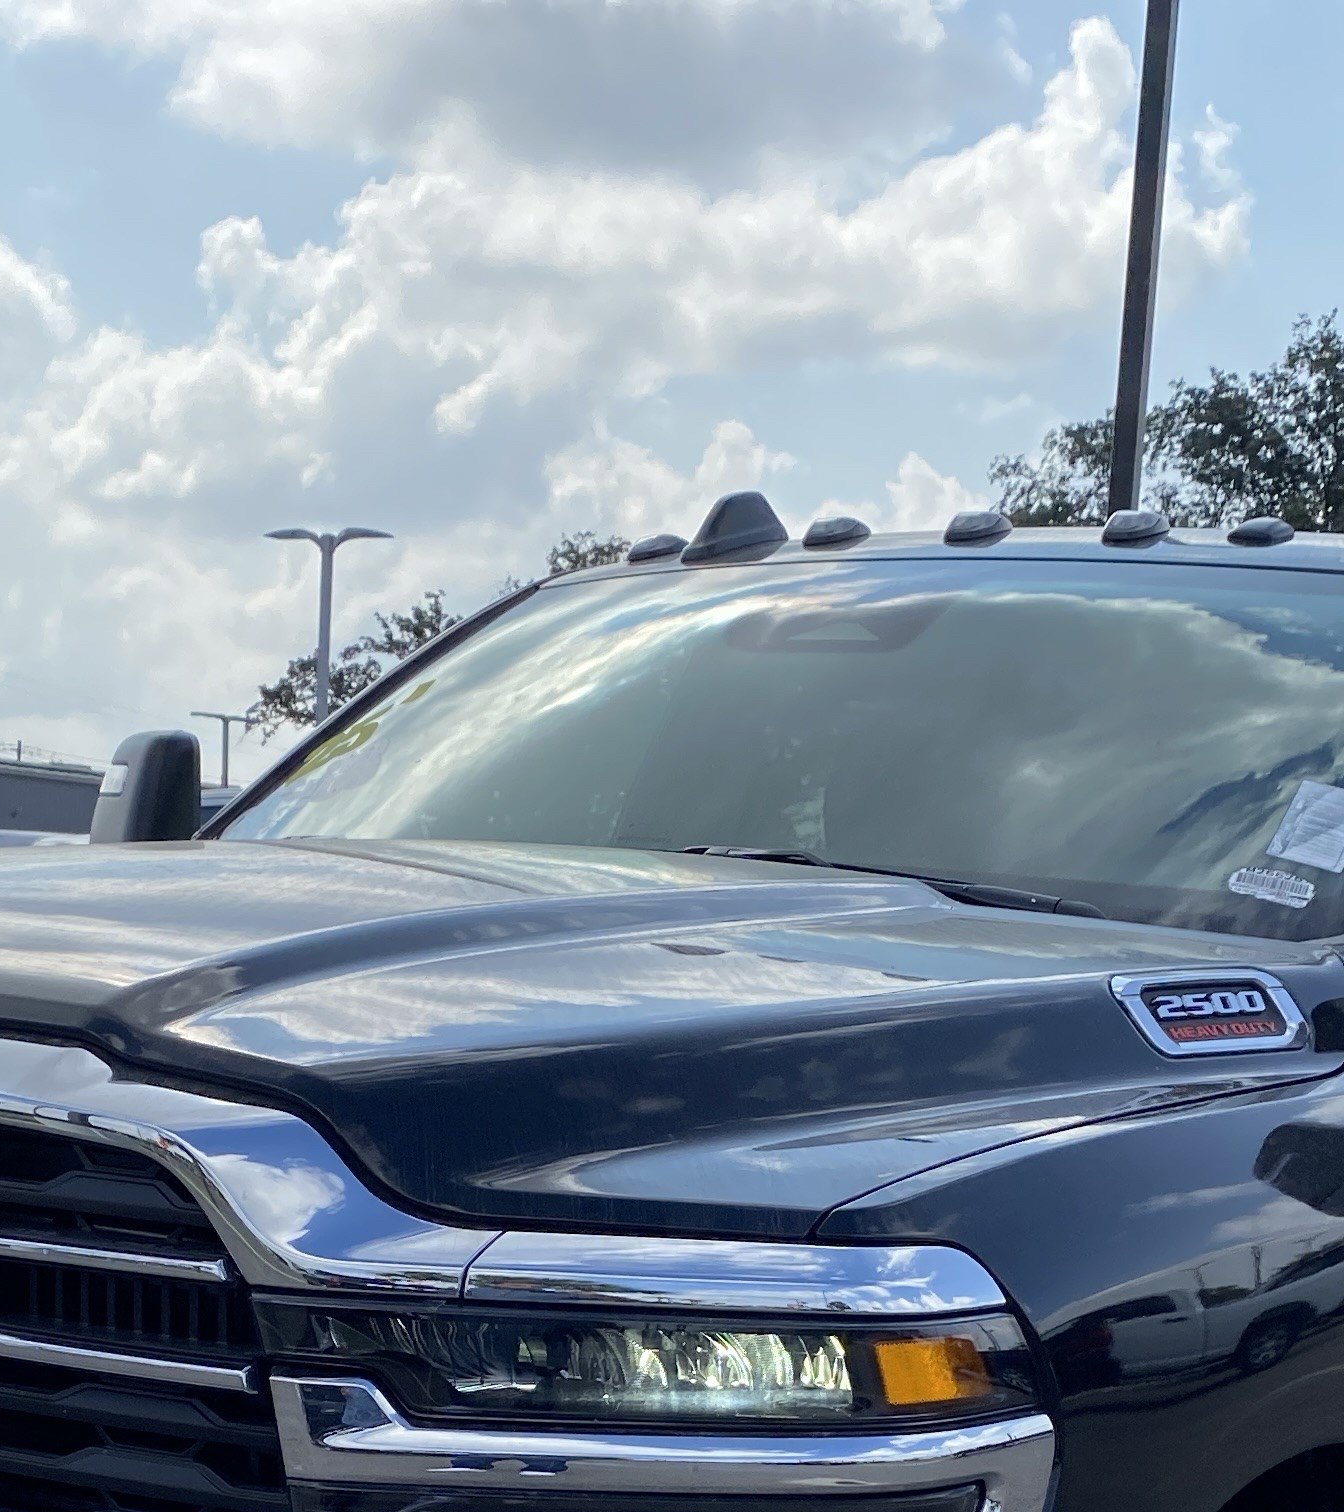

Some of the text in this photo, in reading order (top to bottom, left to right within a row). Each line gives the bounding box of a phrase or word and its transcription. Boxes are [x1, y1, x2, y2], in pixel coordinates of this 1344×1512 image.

[1151, 990, 1266, 1019] 2500
[1168, 1020, 1277, 1039] HEAVY DUTY
